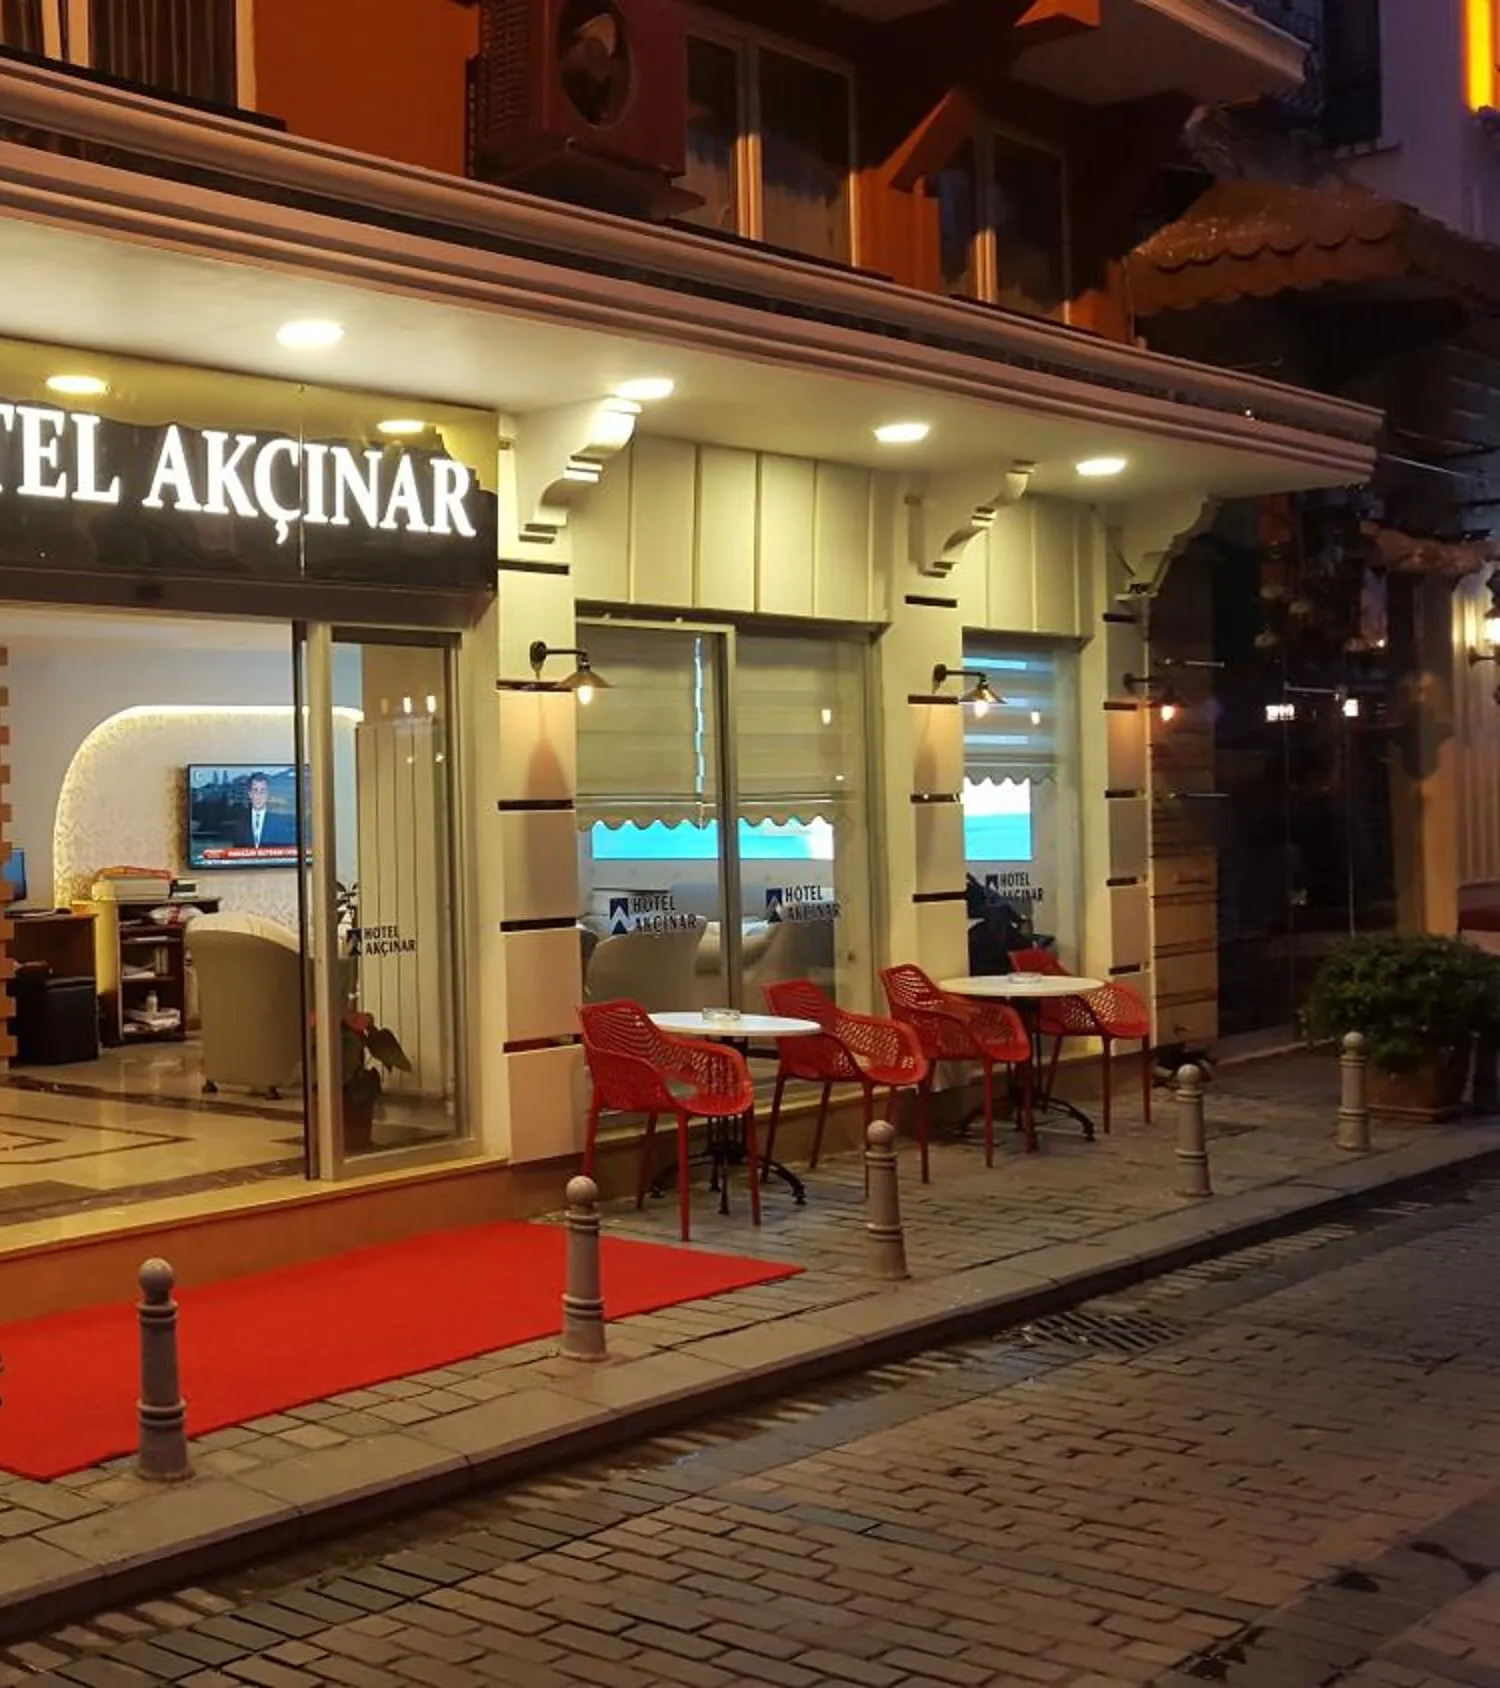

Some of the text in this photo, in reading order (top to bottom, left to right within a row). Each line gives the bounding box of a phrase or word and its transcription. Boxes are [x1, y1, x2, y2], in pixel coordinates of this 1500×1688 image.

[141, 424, 477, 544] AKÇINAR
[1000, 871, 1030, 887] HOTEL
[785, 884, 823, 902] HOTEL
[633, 895, 677, 913] HOTEL
[363, 925, 399, 940] HOTEL
